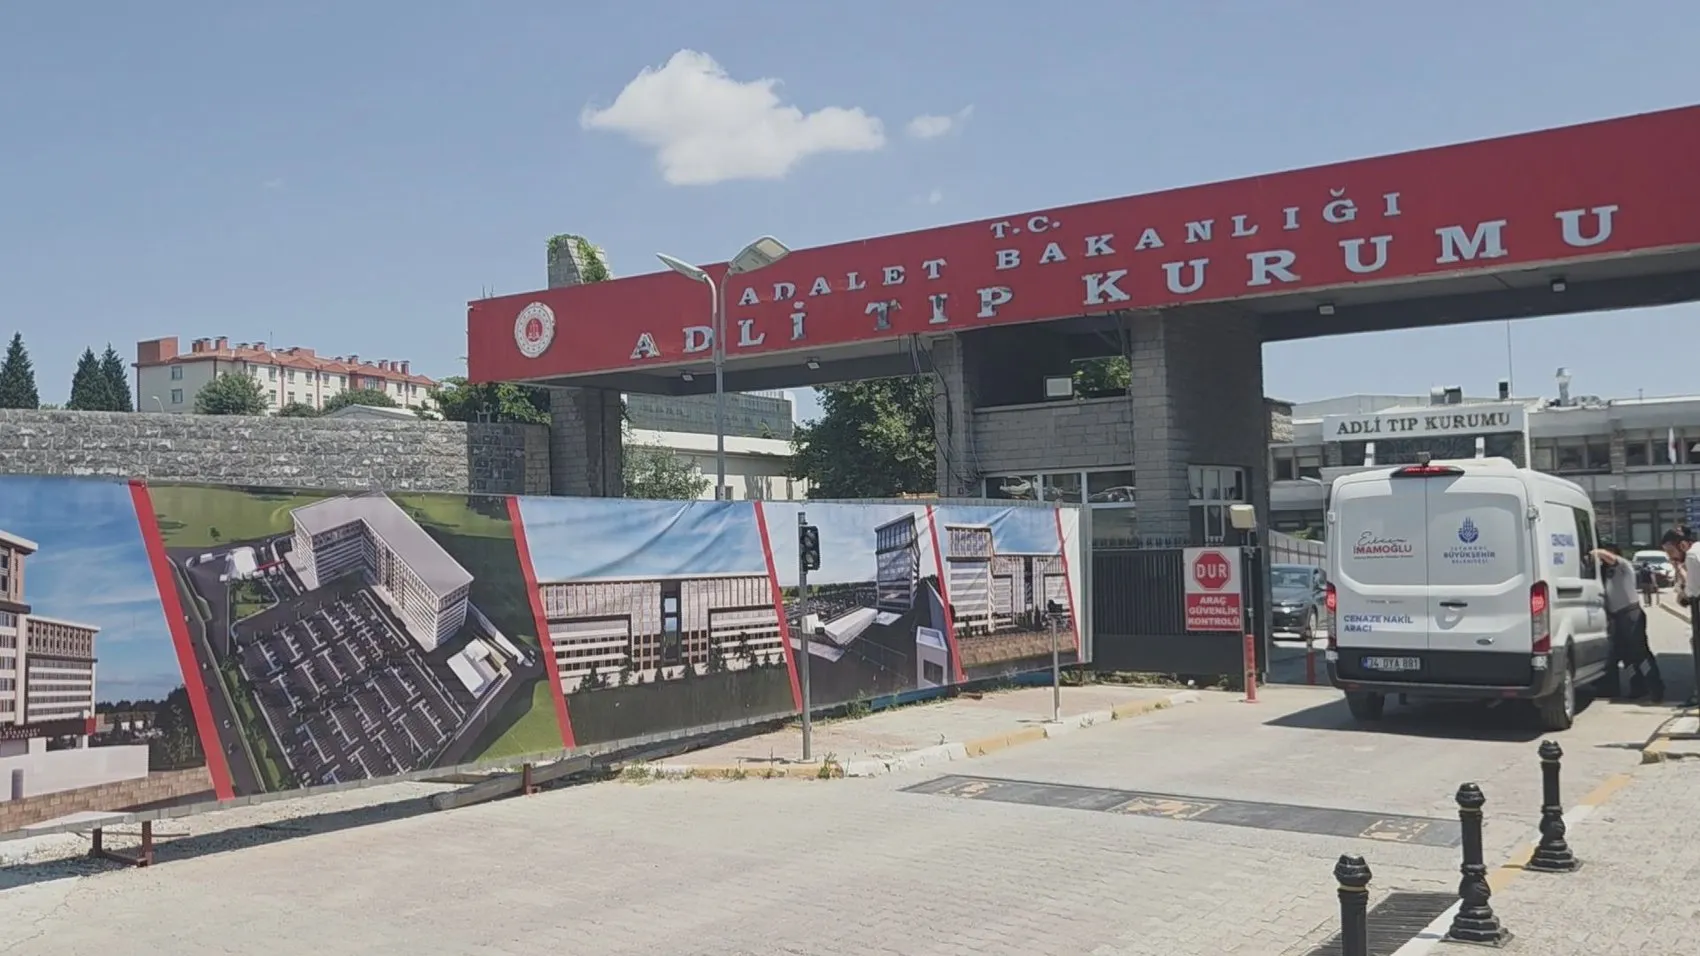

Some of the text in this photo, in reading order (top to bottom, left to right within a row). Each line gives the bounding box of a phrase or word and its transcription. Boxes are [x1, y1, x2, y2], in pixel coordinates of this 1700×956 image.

[990, 214, 1061, 239] T.C.
[738, 187, 1401, 306] ADALET BAKANLIĞI
[630, 204, 1619, 360] ADLİ TIP KURUMU
[1337, 412, 1510, 435] ADLİ TIP KURUMU
[1353, 543, 1412, 554] İMAMOĞLU
[1443, 550, 1496, 559] BÜYÜKŞEHİR
[1196, 563, 1228, 578] DUR
[1199, 596, 1227, 606] ARAÇ
[1188, 606, 1238, 615] GÜVENLİK
[1188, 617, 1240, 625] KONTROLÜ
[1343, 613, 1414, 624] CENAZE NAKİL
[1344, 624, 1372, 633] ARACI
